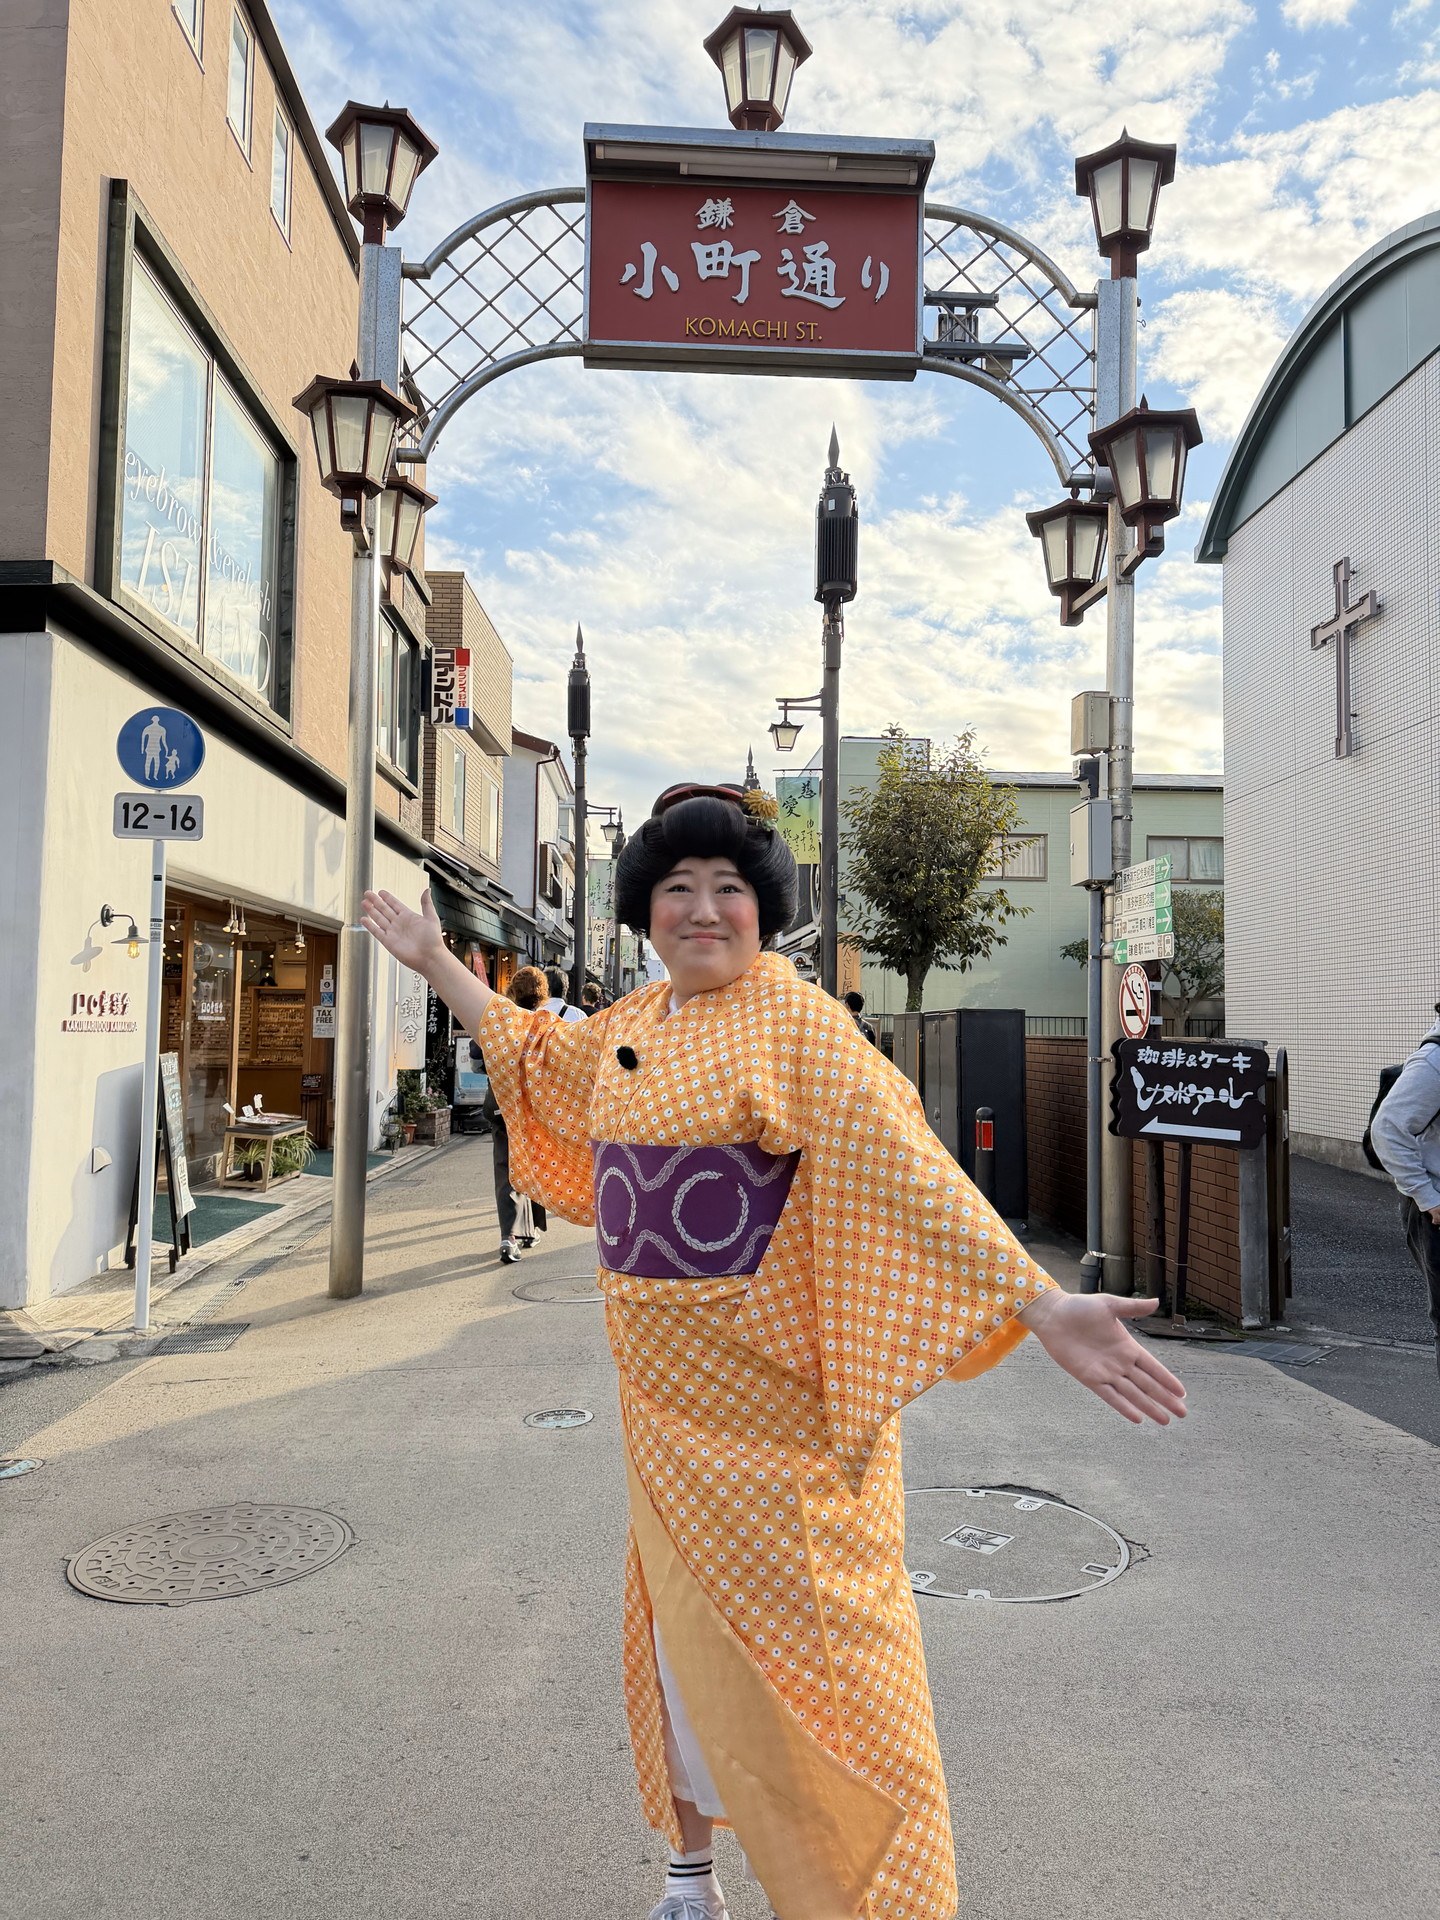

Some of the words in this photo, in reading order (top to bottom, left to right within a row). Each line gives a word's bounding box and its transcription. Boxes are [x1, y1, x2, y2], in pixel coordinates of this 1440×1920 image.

[694, 197, 817, 236] 鎌倉
[618, 239, 891, 310] 小町通り
[685, 317, 789, 341] KOMACHI
[795, 321, 824, 342] ST.
[124, 450, 202, 547] eyebrow
[133, 520, 271, 693] ISLAND
[433, 648, 455, 724] コアンドル
[122, 802, 197, 832] 12-16
[317, 1009, 332, 1017] TAX
[1137, 1046, 1252, 1075] 珈琲&ケーキ
